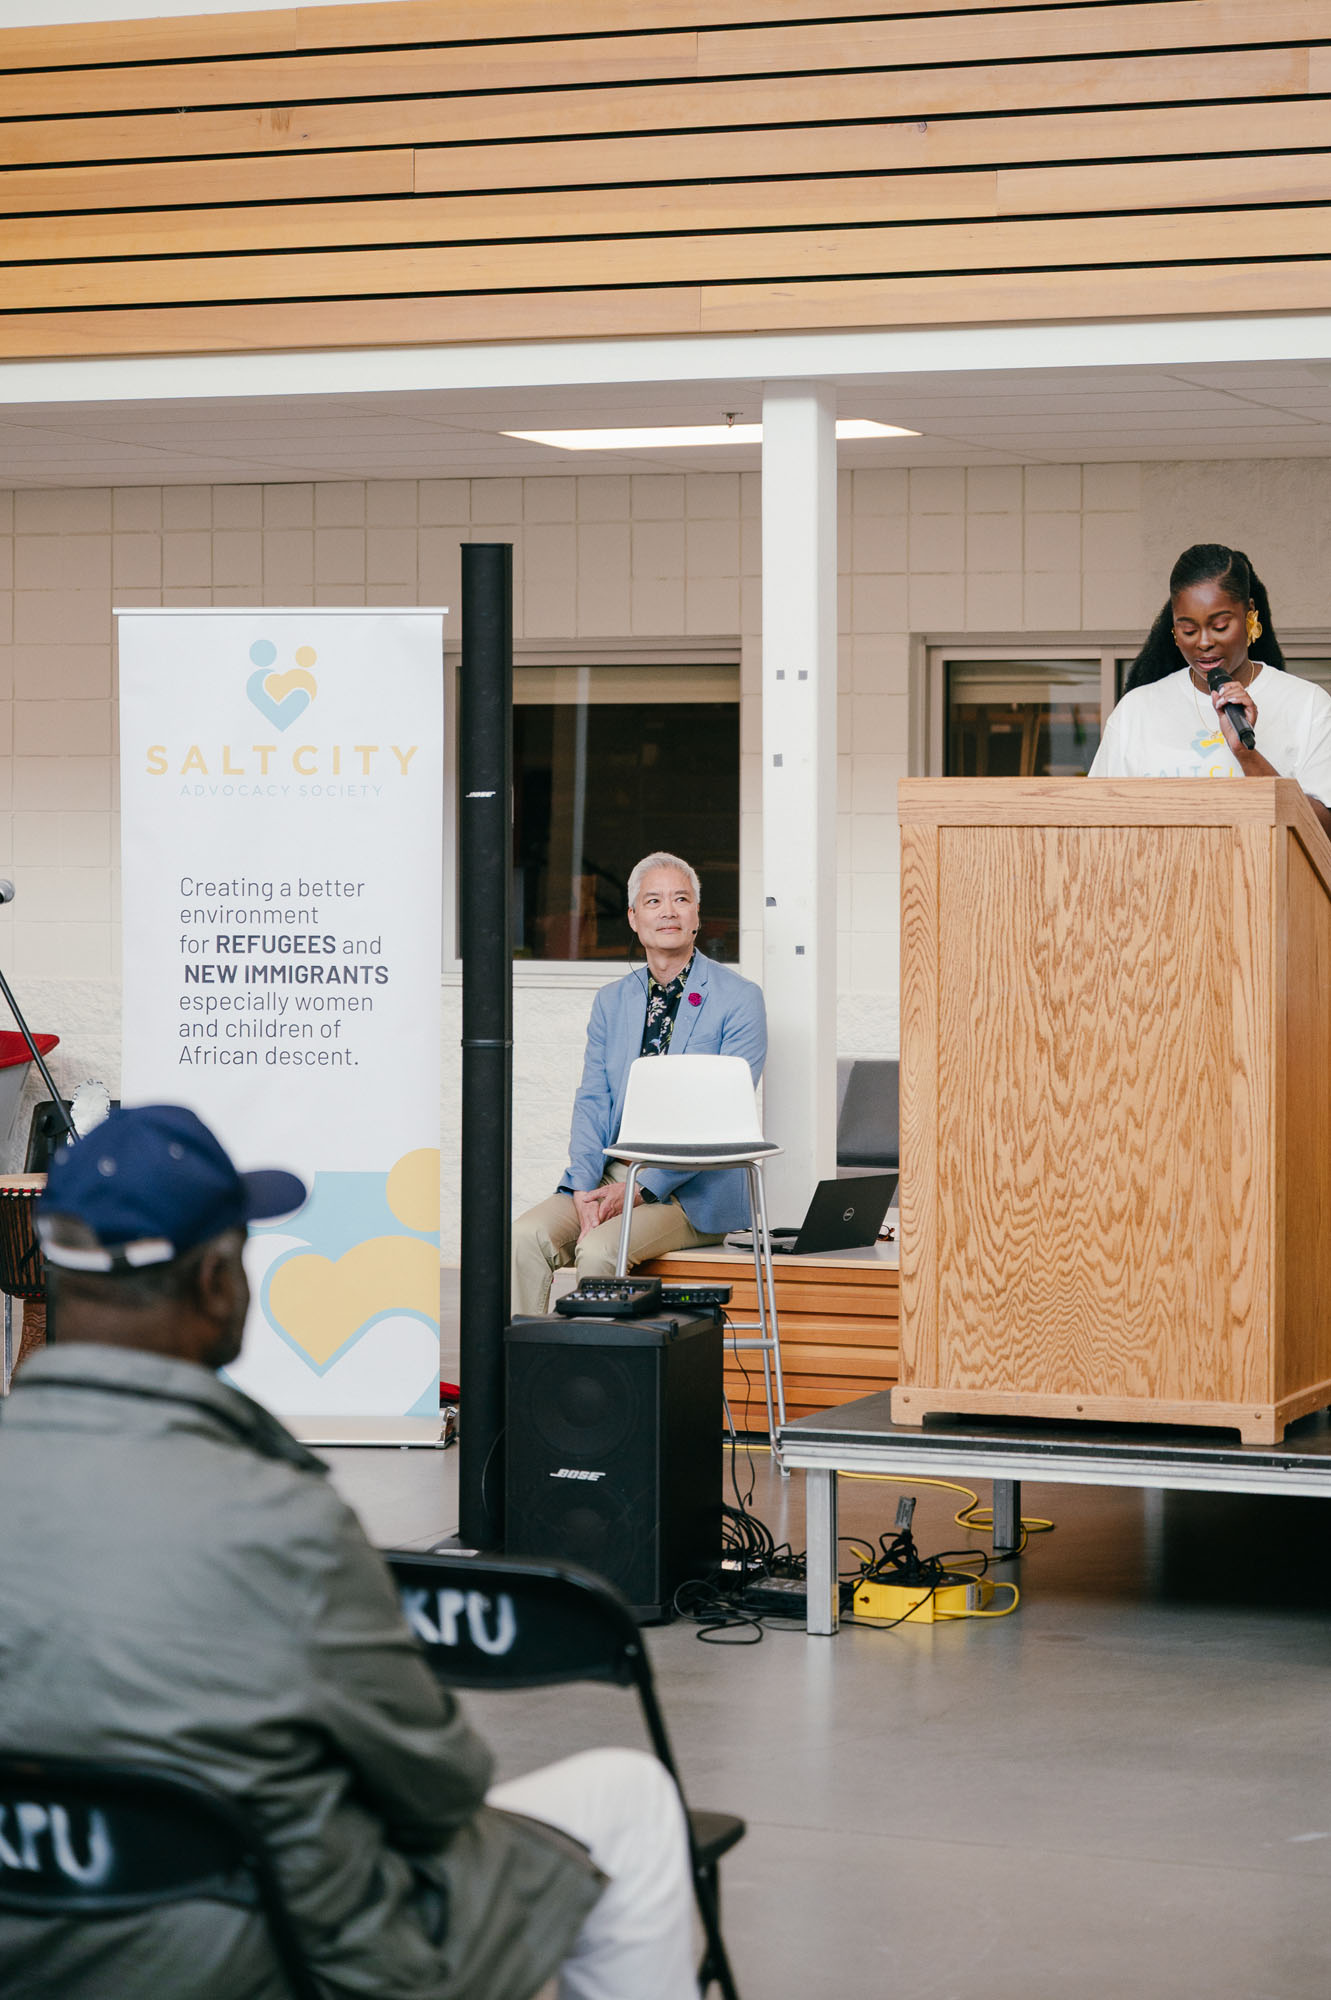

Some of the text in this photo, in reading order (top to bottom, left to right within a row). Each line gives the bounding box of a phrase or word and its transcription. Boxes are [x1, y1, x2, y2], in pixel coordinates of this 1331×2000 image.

[180, 784, 383, 797] ADVOCACY SOCIETY
[180, 877, 365, 901] Creating a better
[180, 905, 319, 924] environment
[179, 934, 382, 954] for REFUGEES and
[184, 964, 389, 985] NEW IMMIGRANTS
[179, 991, 373, 1016] especially women
[178, 1018, 342, 1039] and children of
[178, 1045, 359, 1066] African descent.
[550, 1469, 606, 1481] BOSE
